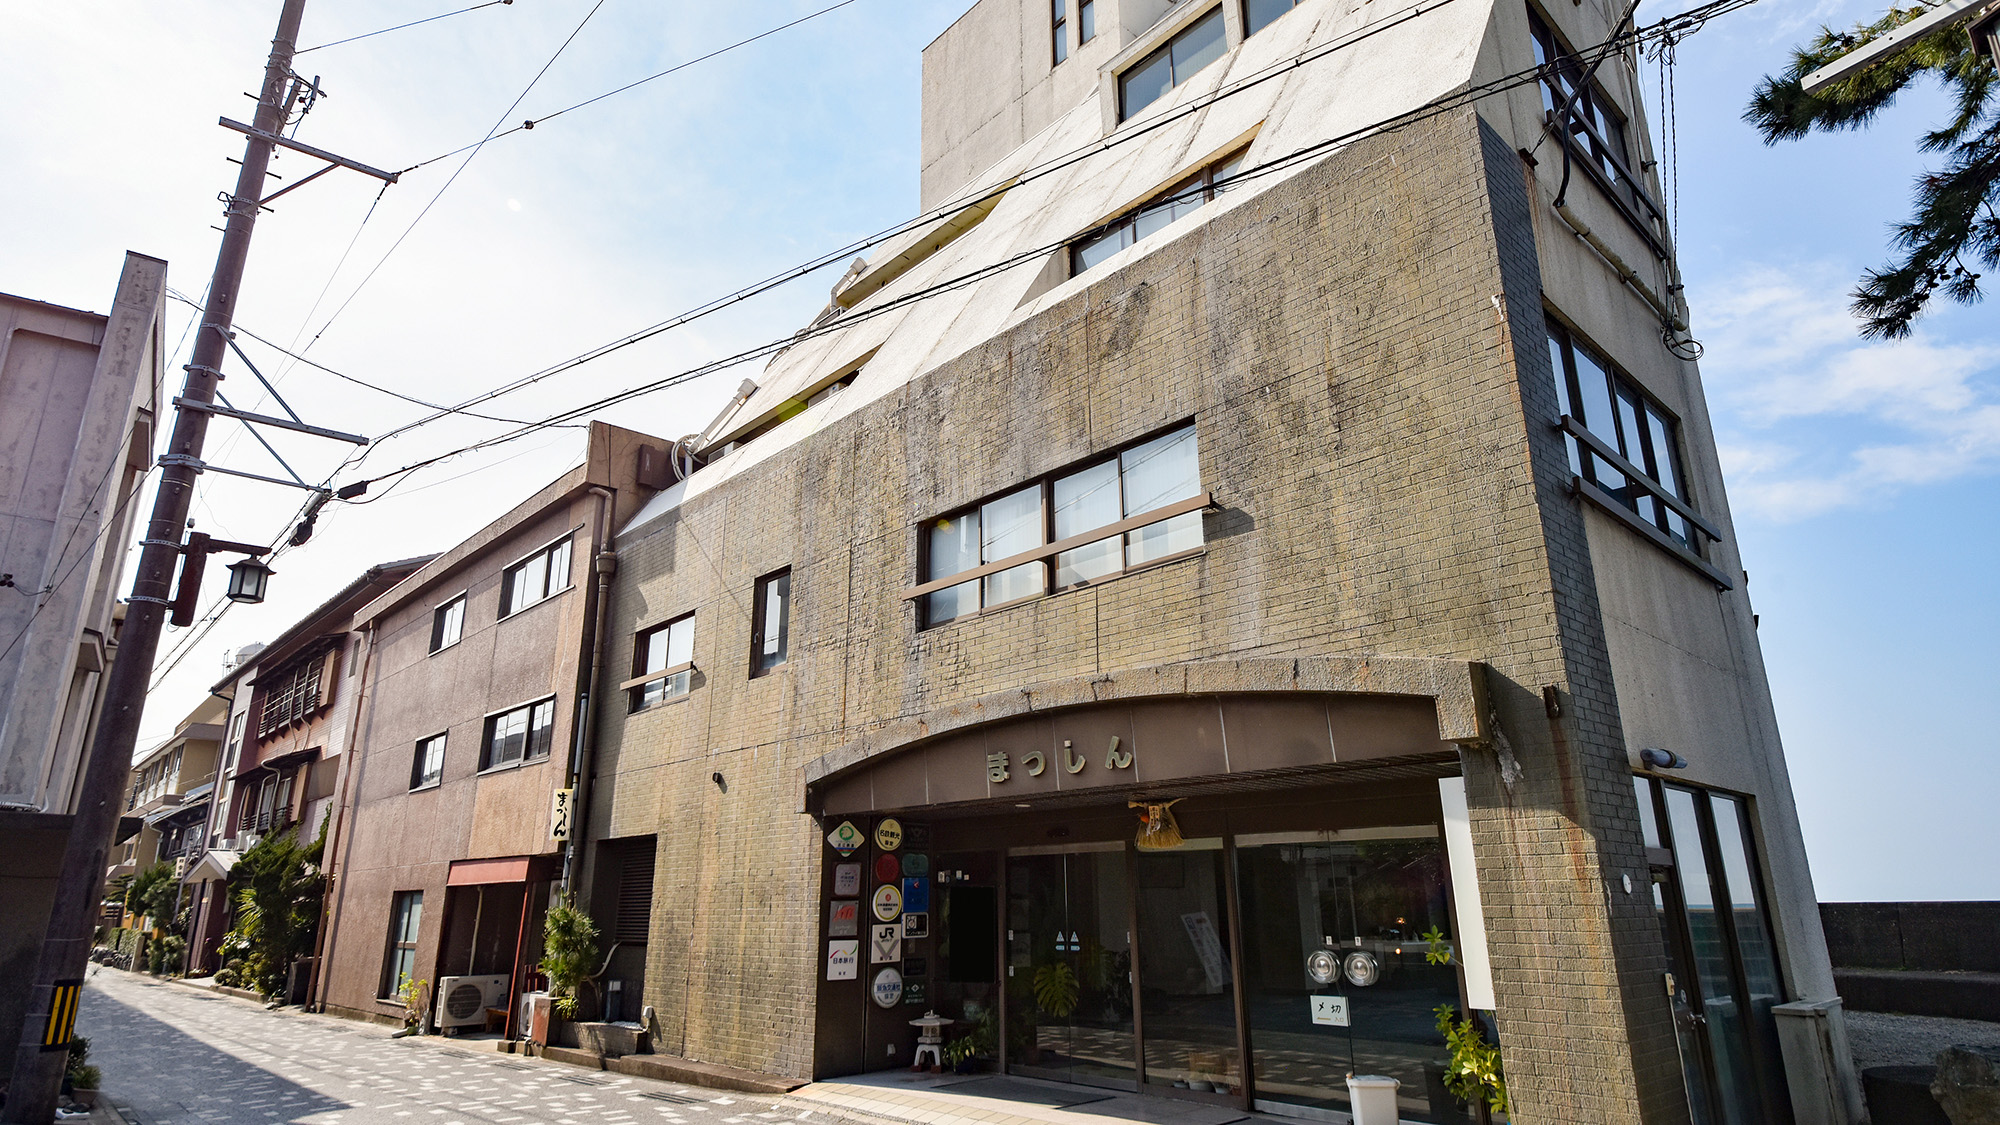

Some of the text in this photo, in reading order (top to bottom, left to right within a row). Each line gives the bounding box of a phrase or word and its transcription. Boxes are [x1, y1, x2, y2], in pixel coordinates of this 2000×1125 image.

[987, 735, 1133, 783] まっしん
[553, 791, 568, 837] まっしん
[879, 927, 894, 938] JR
[832, 957, 854, 965] 日本旅行
